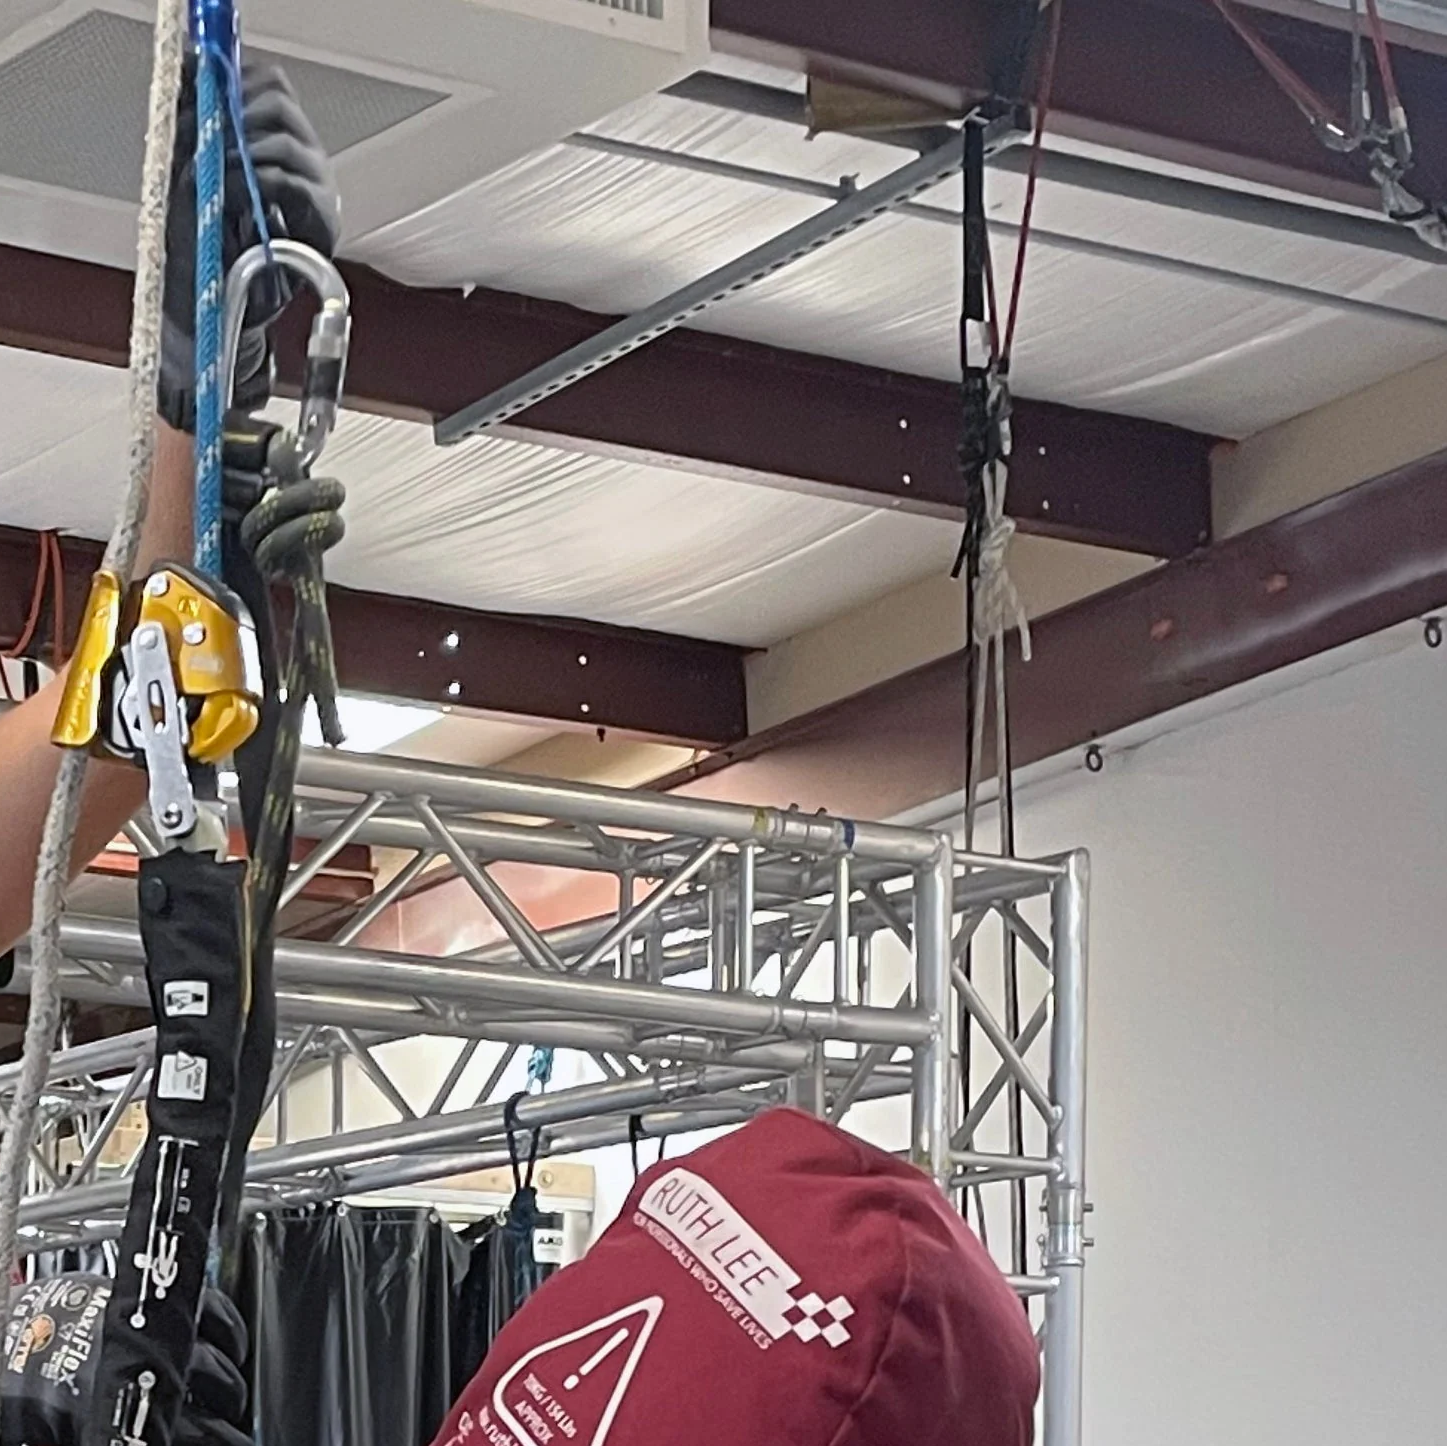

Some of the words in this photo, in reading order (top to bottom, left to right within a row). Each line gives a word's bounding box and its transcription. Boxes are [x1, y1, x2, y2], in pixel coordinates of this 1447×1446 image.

[650, 1177, 725, 1241] RUTH
[710, 1234, 780, 1297] LEE
[712, 1290, 741, 1320] SAVE
[738, 1315, 774, 1349] LIVES
